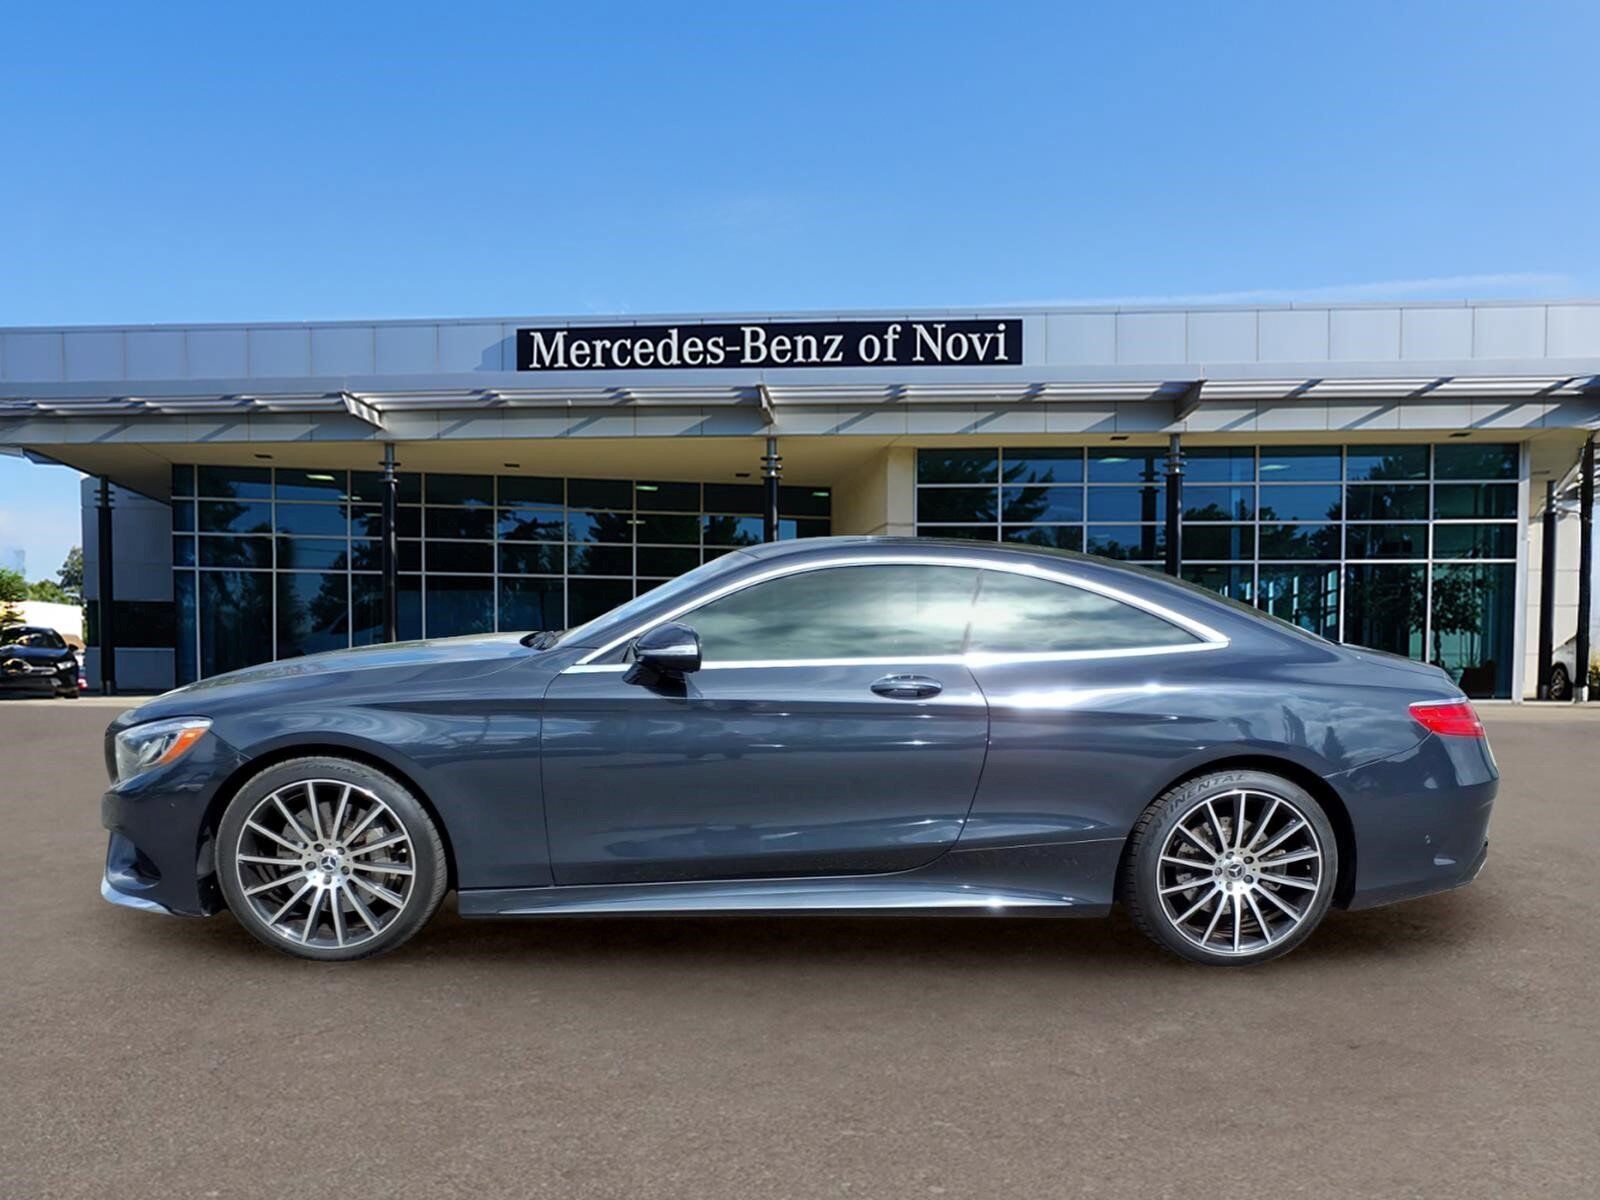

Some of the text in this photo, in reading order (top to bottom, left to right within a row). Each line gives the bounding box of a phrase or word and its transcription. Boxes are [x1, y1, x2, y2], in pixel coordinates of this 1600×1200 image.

[529, 323, 1009, 369] Mercedes-Benz of Novi
